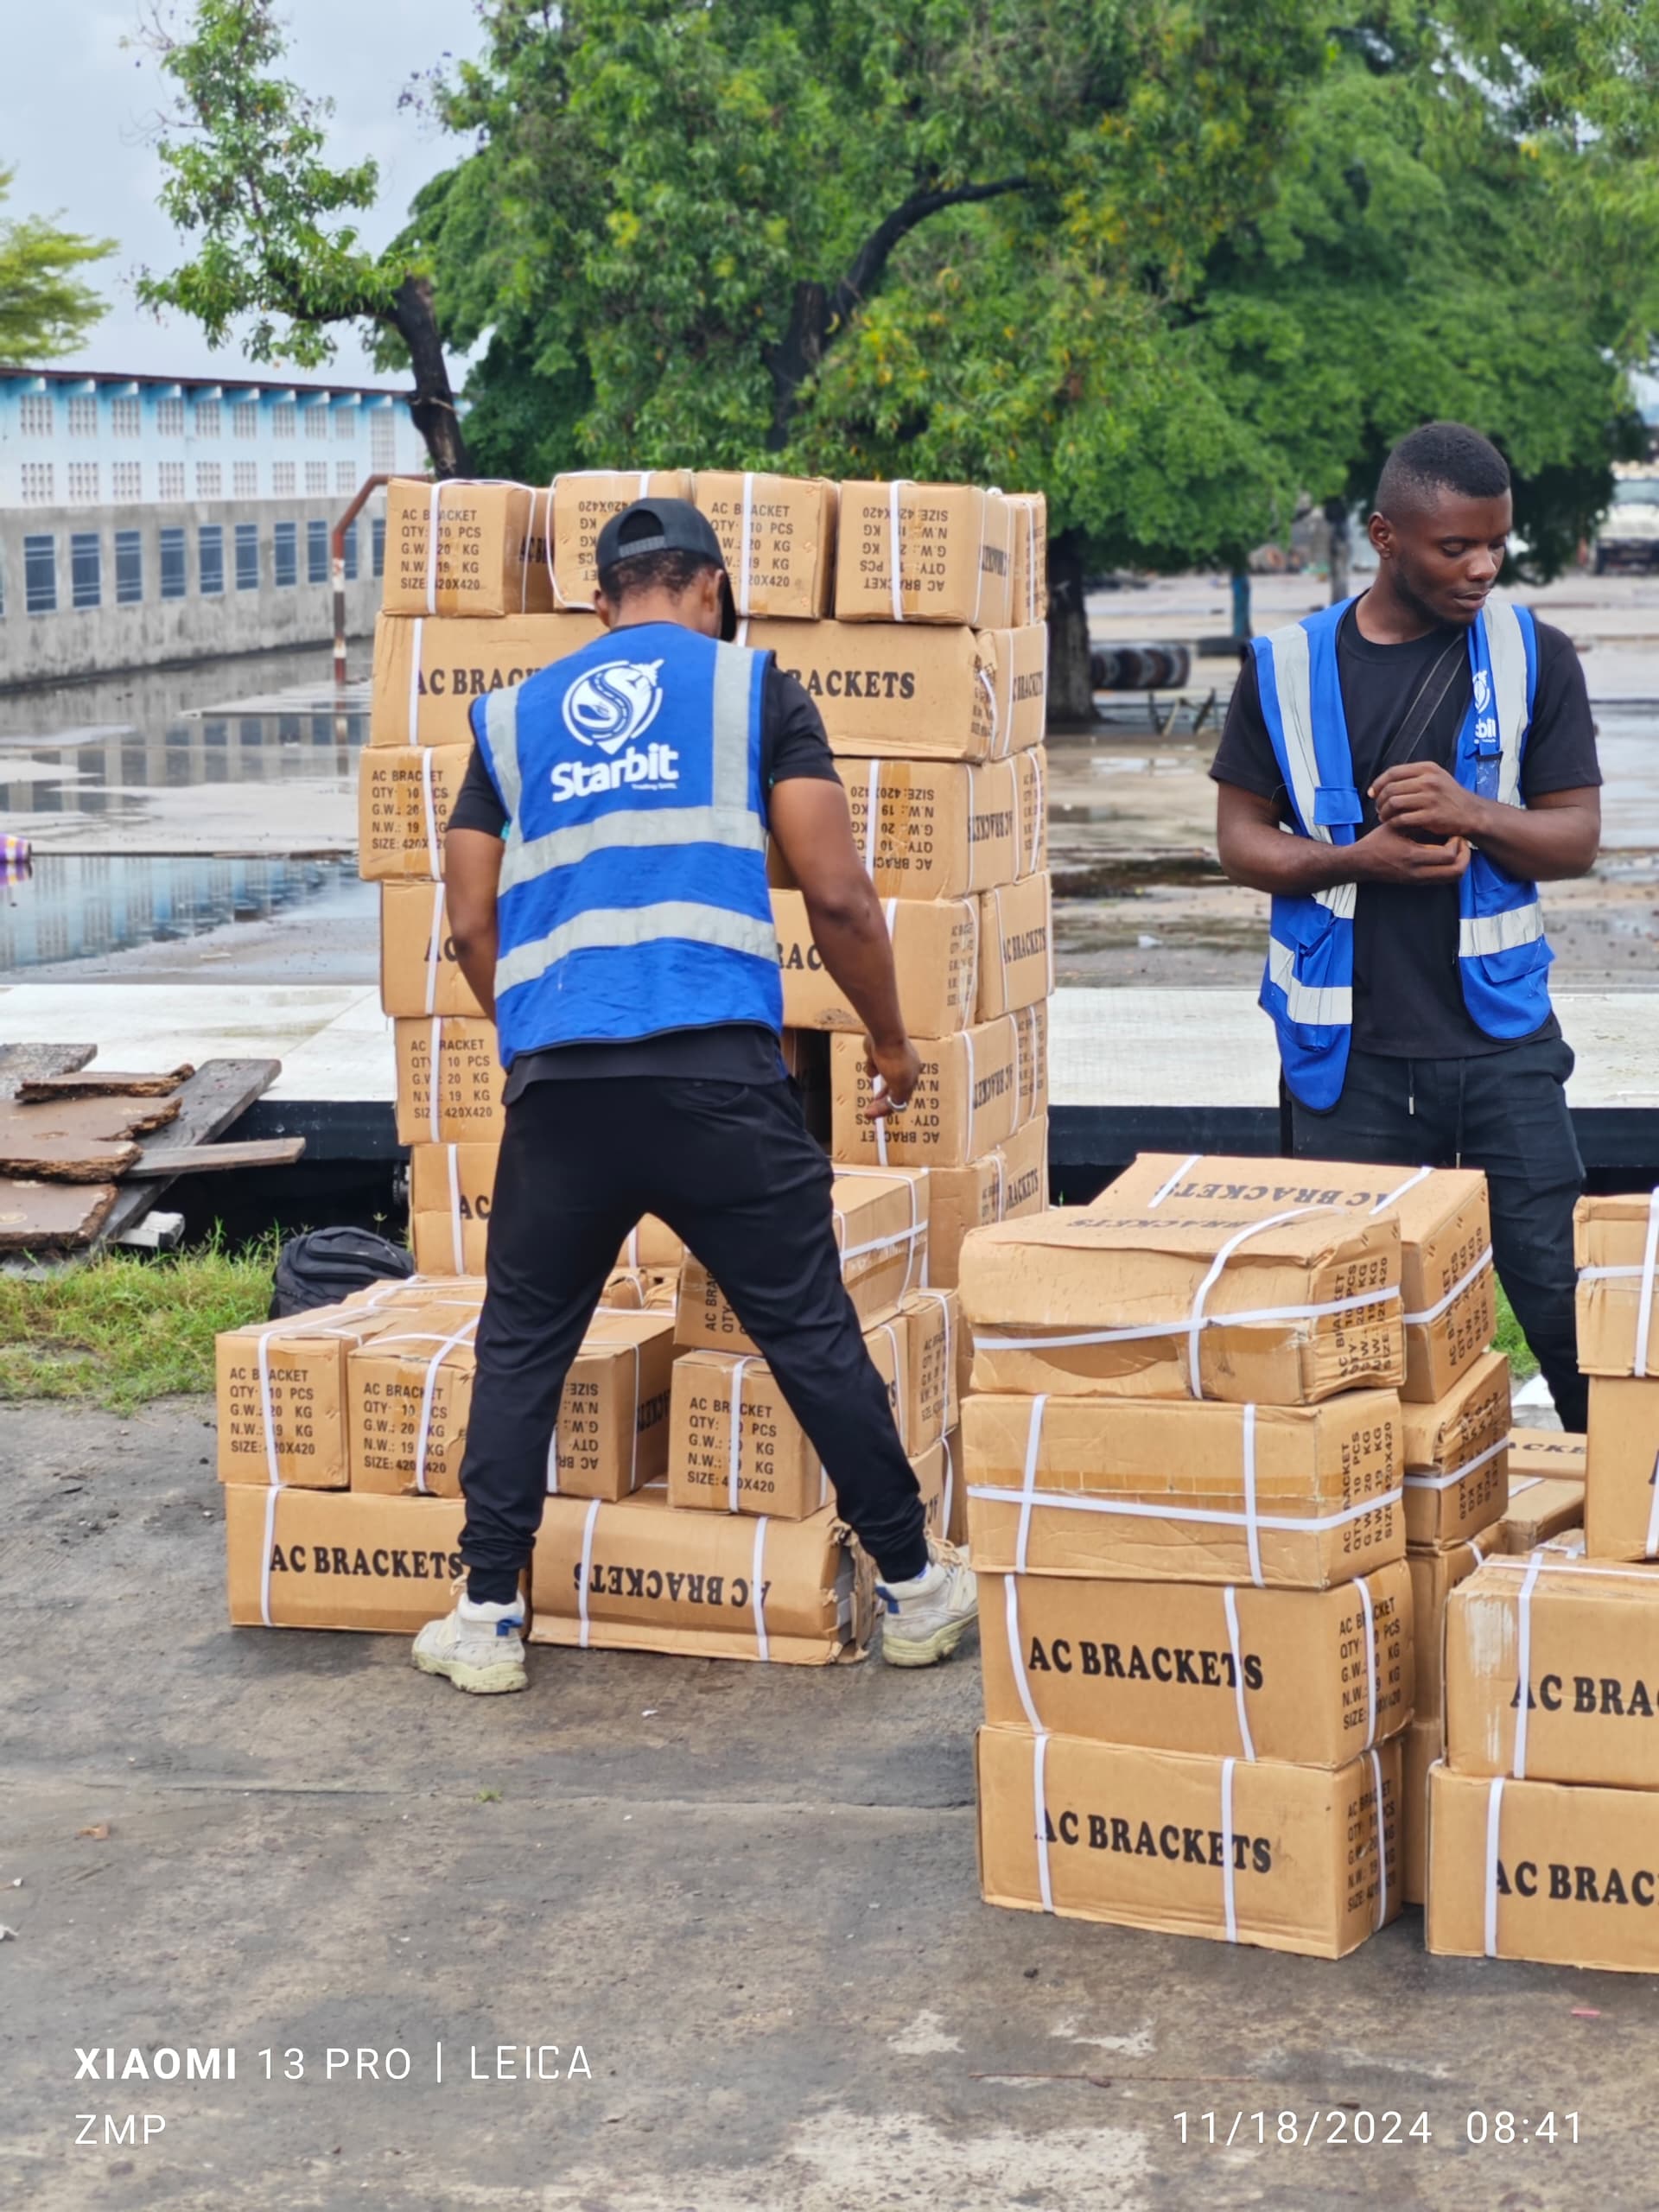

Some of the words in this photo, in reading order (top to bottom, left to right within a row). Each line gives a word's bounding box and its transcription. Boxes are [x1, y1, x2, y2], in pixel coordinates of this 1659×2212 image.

[402, 509, 417, 520] AC
[423, 509, 477, 521] BACKET
[712, 503, 728, 514] AC
[734, 504, 790, 518] BACKET
[862, 507, 914, 520] 42X420
[580, 518, 597, 529] KG
[749, 522, 762, 533] 10
[770, 522, 793, 535] PCS
[438, 527, 451, 537] 10
[458, 527, 481, 538] PCS
[864, 524, 881, 537] KG
[436, 543, 451, 555] 20
[462, 544, 480, 556] KG
[773, 540, 791, 552] KG
[862, 542, 880, 555] KG
[578, 553, 594, 564] CS
[772, 557, 790, 570] KG
[437, 562, 450, 572] 19
[462, 562, 480, 574] KG
[860, 560, 884, 572] PCS
[435, 578, 480, 590] 20X420
[927, 580, 944, 592] AC
[418, 668, 444, 695] AC
[372, 770, 387, 781] AC
[391, 770, 443, 782] BRACET
[550, 742, 680, 802] Starbit
[407, 788, 419, 798] 10
[432, 788, 449, 798] CS
[406, 804, 419, 816] 20
[881, 804, 894, 816] 19
[407, 822, 419, 833] 19
[881, 823, 894, 834] 20
[880, 840, 893, 851] 10
[916, 858, 933, 871] AC
[410, 1039, 426, 1052] AC
[439, 1039, 484, 1051] RACKET
[448, 1057, 460, 1067] 10
[467, 1055, 490, 1067] PCS
[448, 1073, 461, 1084] 20
[473, 1072, 490, 1084] KG
[449, 1091, 462, 1102] 19
[474, 1090, 491, 1102] KG
[444, 1107, 493, 1118] 420X420
[861, 1130, 917, 1143] BRACET
[923, 1131, 940, 1144] AC
[460, 1195, 490, 1220] AC
[1358, 1264, 1368, 1288] KG
[1369, 1262, 1378, 1286] KG
[704, 1313, 717, 1332] AC
[230, 1367, 246, 1380] AC
[251, 1368, 308, 1382] BACKET
[269, 1387, 283, 1399] 10
[289, 1387, 314, 1400] PCS
[364, 1382, 380, 1395] AC
[295, 1405, 313, 1419] KG
[402, 1404, 415, 1416] 10
[430, 1406, 448, 1419] CS
[690, 1397, 707, 1411] AC
[714, 1400, 772, 1418] BRCKET
[295, 1424, 313, 1437] KG
[400, 1422, 415, 1434] 20
[428, 1424, 445, 1437] KG
[689, 1415, 718, 1431] QTY:
[752, 1422, 777, 1438] PCS
[1363, 1430, 1372, 1456] KG
[1374, 1427, 1383, 1452] KG
[401, 1441, 414, 1453] 19
[427, 1444, 444, 1457] KG
[755, 1441, 775, 1456] KG
[1351, 1431, 1361, 1466] PCS
[396, 1459, 447, 1474] 420420
[581, 1457, 599, 1470] AC
[754, 1460, 774, 1476] KG
[687, 1471, 720, 1486] SIZE:
[721, 1476, 775, 1494] 40X420
[1354, 1477, 1363, 1496] 10
[1363, 1472, 1372, 1493] 20
[1344, 1530, 1352, 1554] AC
[270, 1544, 306, 1573] AC
[313, 1547, 464, 1579] BRACKETS
[574, 1562, 723, 1606] BRACKETS
[1340, 1618, 1353, 1637] AC
[1384, 1618, 1401, 1641] PCS
[1388, 1643, 1401, 1662] KG
[1028, 1637, 1072, 1673] AC
[1078, 1641, 1263, 1690] BRACKETS
[1388, 1666, 1401, 1685] KG
[1510, 1674, 1562, 1711] AC
[1573, 1676, 1659, 1717] BRA
[1035, 1808, 1079, 1845] AC
[1087, 1814, 1271, 1873] BRACKETS
[1548, 1864, 1659, 1907] BRAC
